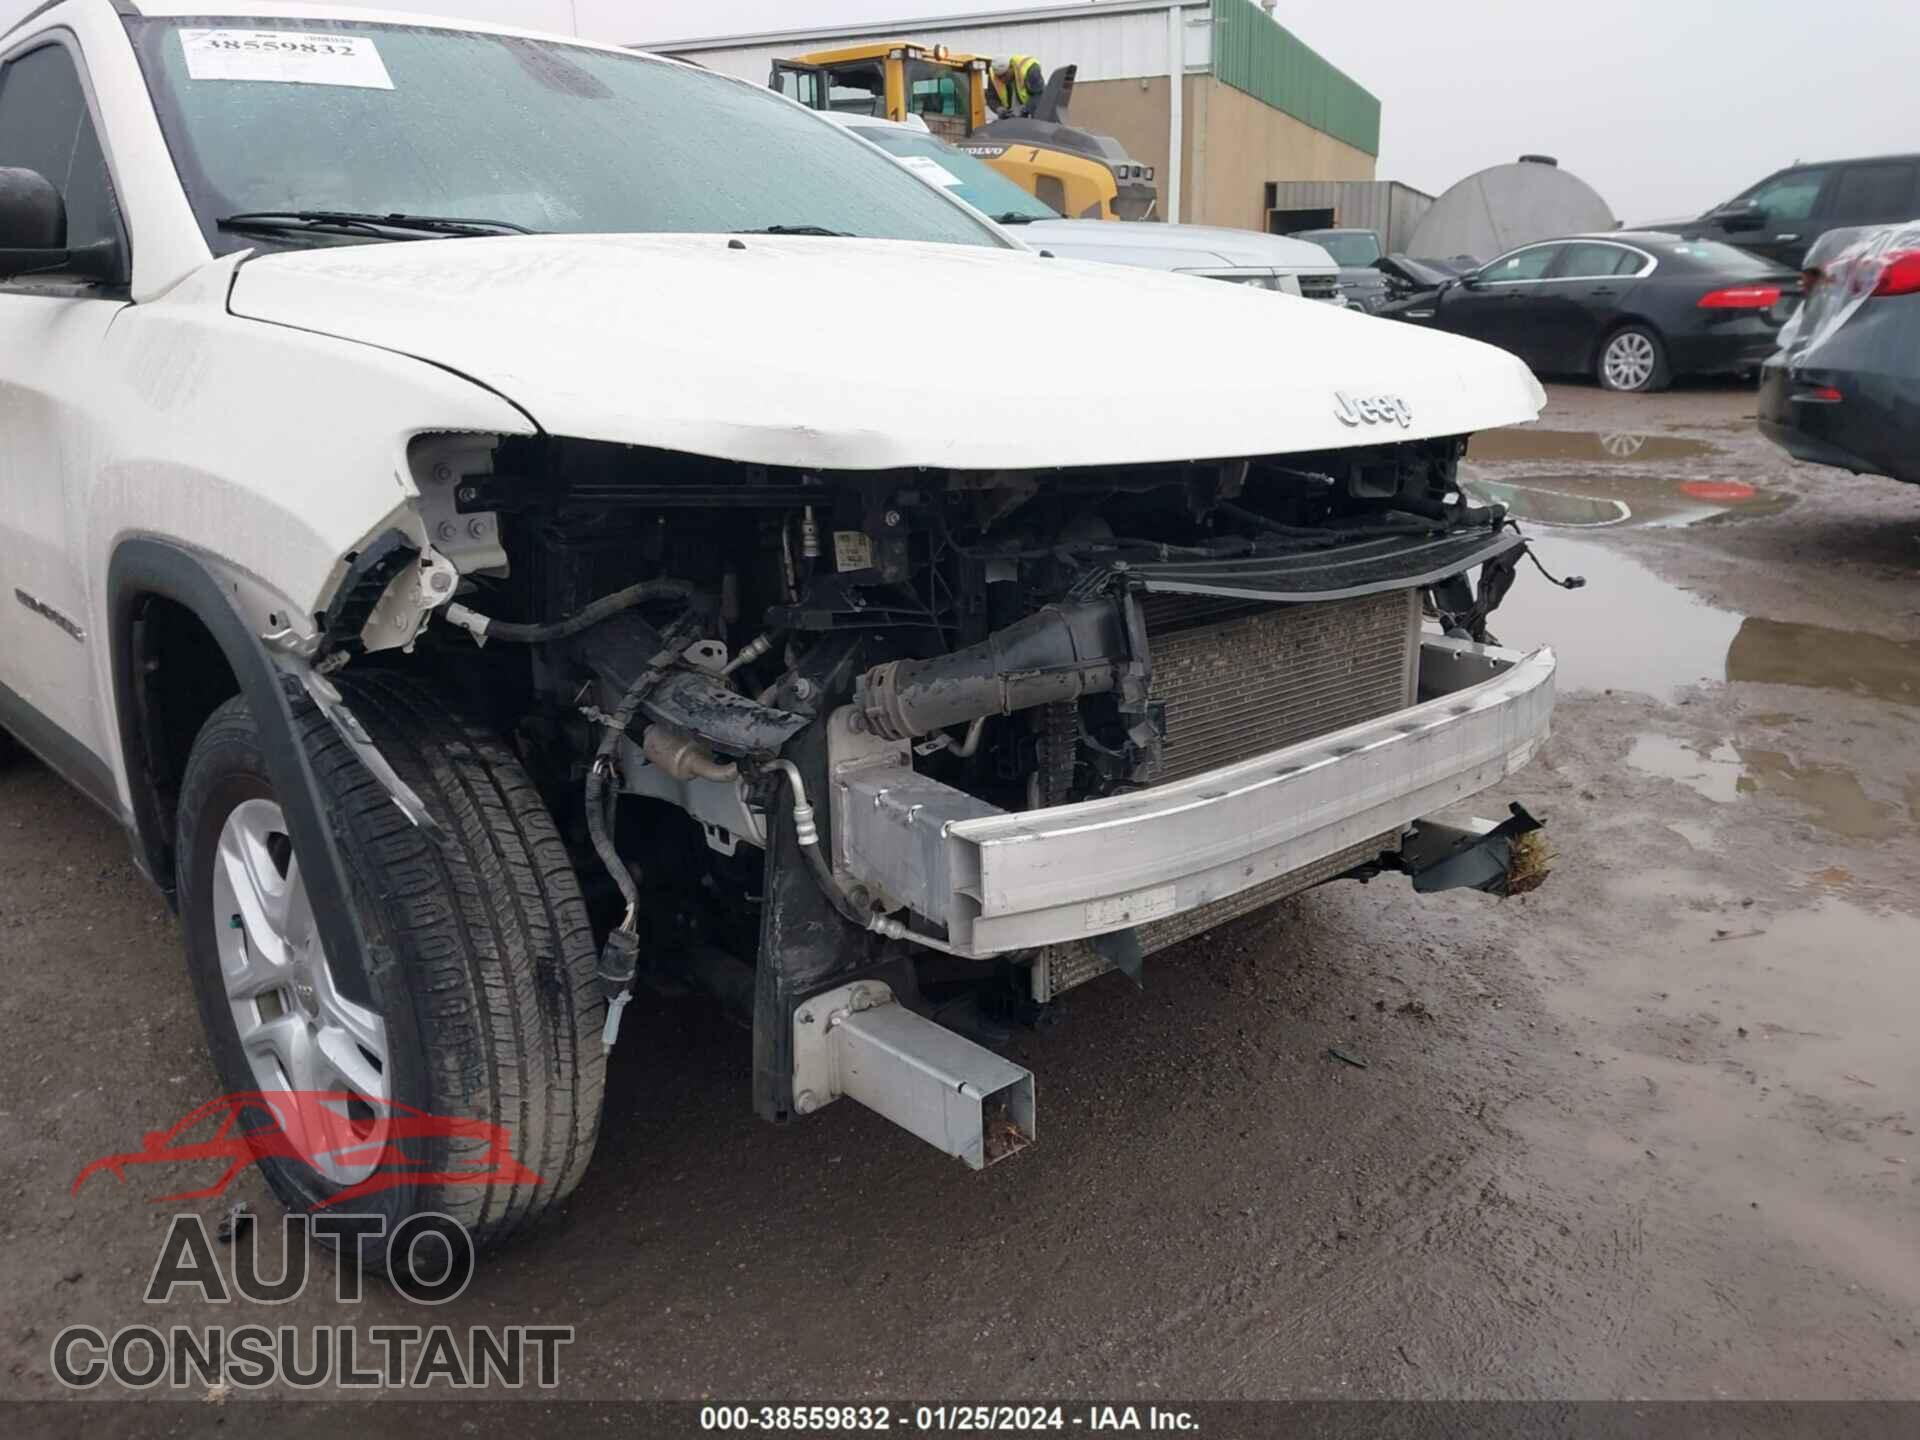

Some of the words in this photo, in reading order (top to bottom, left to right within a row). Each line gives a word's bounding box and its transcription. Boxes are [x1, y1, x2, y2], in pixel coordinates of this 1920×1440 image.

[204, 38, 357, 57] 38559832
[960, 146, 1003, 156] VOLVO
[1029, 149, 1040, 162] 1
[1334, 391, 1412, 430] Jeep
